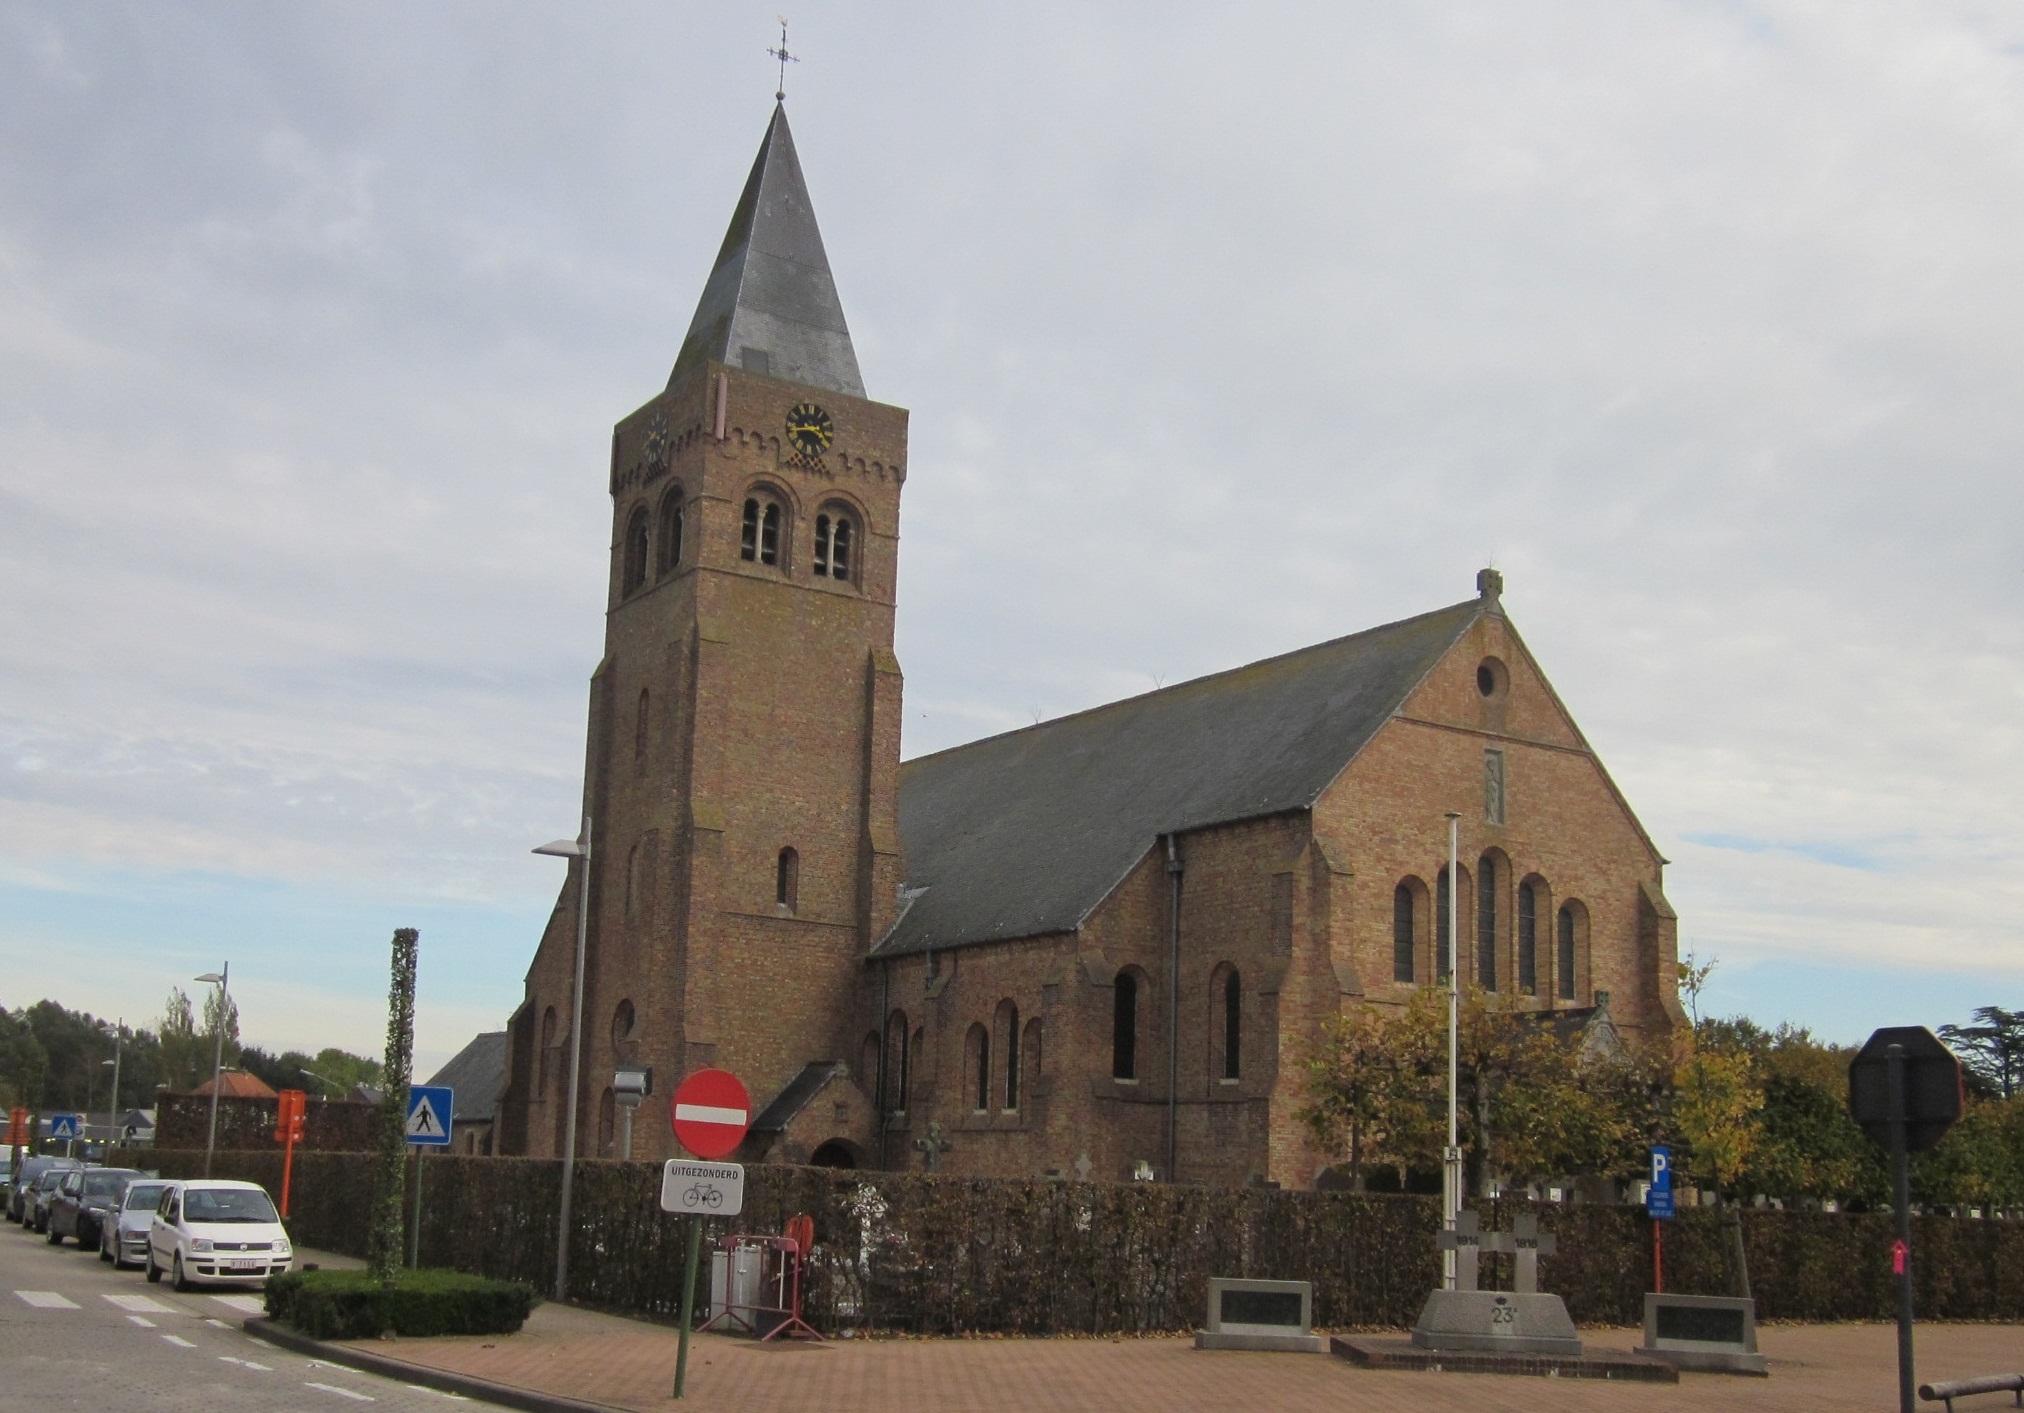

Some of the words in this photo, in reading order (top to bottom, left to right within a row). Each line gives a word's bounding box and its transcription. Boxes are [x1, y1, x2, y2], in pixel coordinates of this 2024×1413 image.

[671, 1166, 738, 1180] UITGEZONDERD
[1653, 1153, 1666, 1183] P
[1456, 1235, 1479, 1246] 1914
